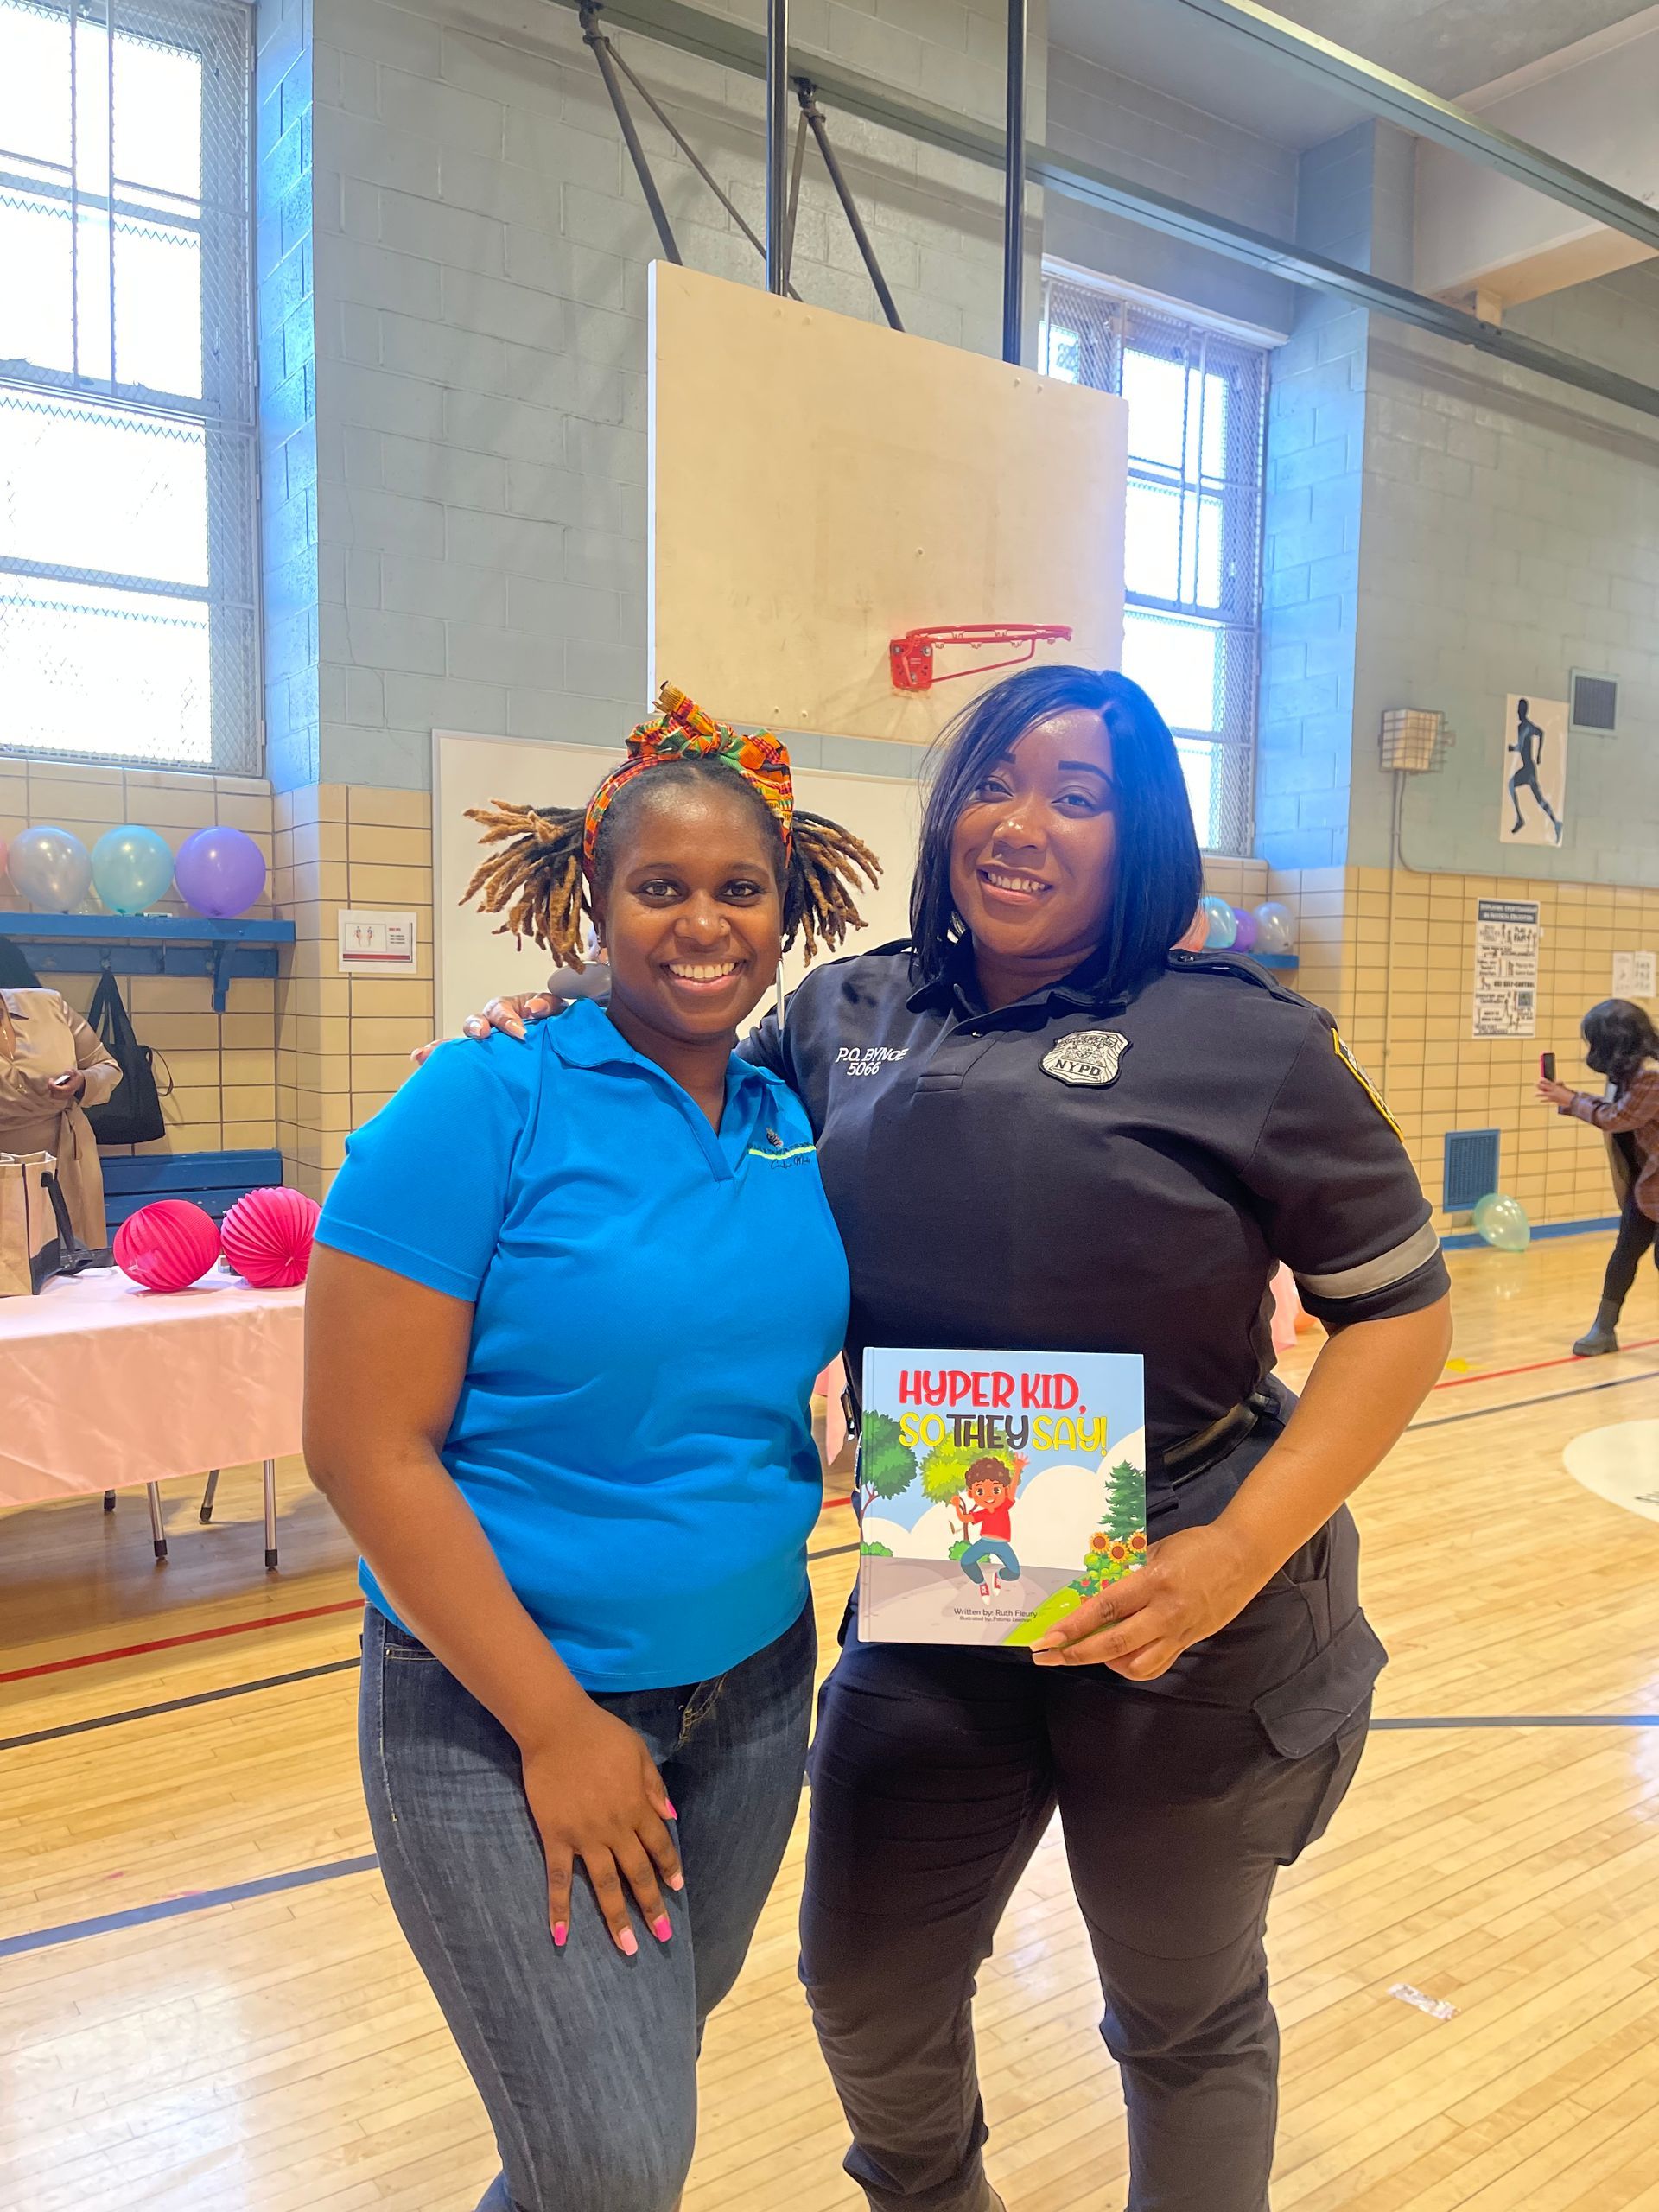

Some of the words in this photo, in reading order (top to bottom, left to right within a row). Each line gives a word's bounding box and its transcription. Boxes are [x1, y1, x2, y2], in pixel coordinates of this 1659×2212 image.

[861, 1046, 909, 1062] BYNOE
[847, 1061, 881, 1076] 5066
[1055, 1059, 1102, 1076] NYPD
[899, 1370, 1015, 1408] HYPER
[1021, 1373, 1086, 1414] KID,
[899, 1411, 946, 1448] SO
[946, 1414, 1029, 1450] THEY
[1032, 1415, 1107, 1457] SAY!
[982, 1608, 994, 1617] by:
[1014, 1609, 1038, 1618] Fleury
